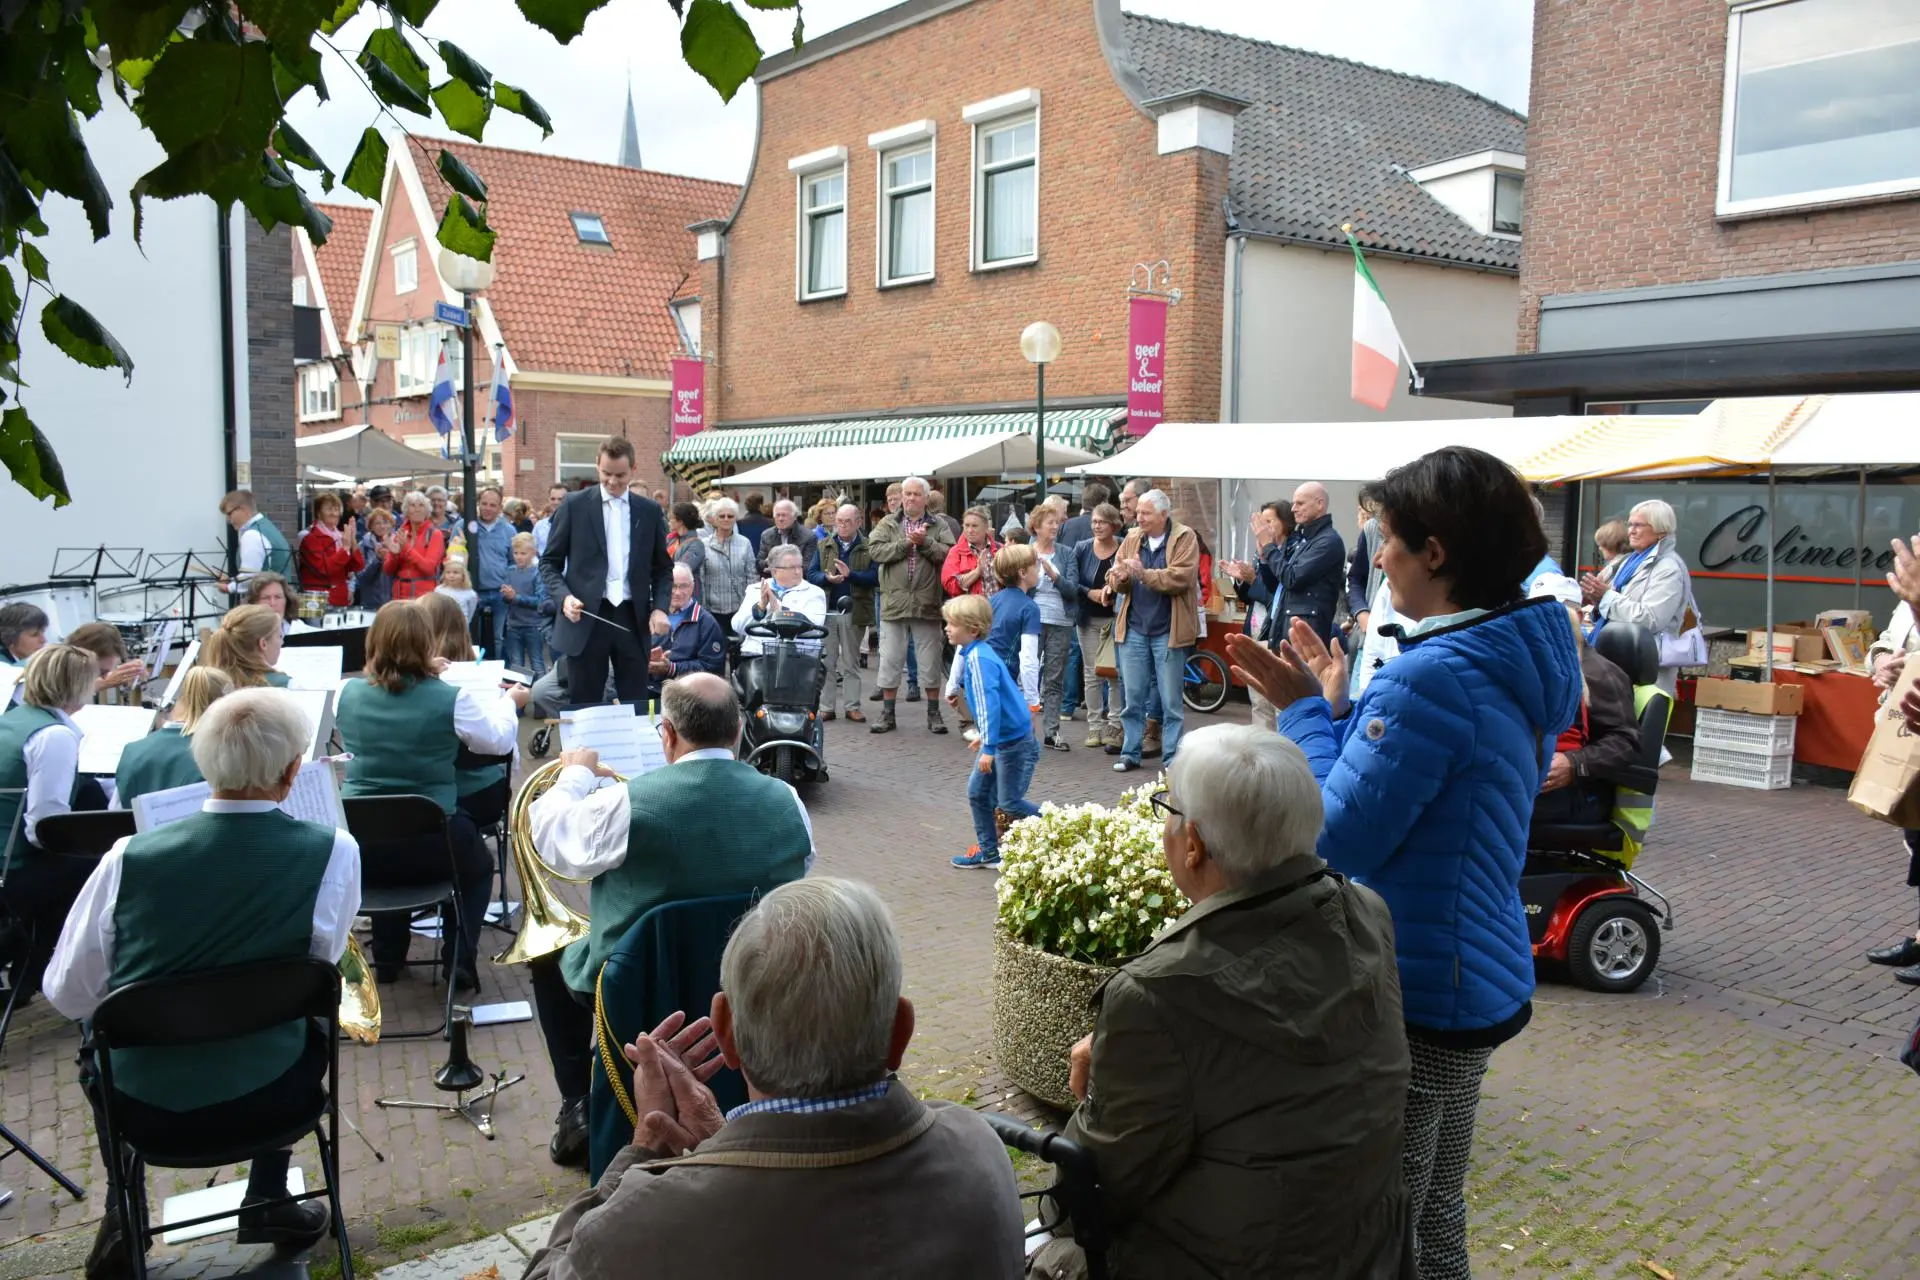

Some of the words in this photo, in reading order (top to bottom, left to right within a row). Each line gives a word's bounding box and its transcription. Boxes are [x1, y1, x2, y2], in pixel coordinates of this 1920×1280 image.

[1135, 342, 1160, 360] geef
[1138, 357, 1157, 378] &
[1131, 377, 1162, 393] beleef
[678, 388, 699, 401] geef
[675, 413, 702, 424] beleef
[1699, 505, 1894, 570] Calimero
[1887, 708, 1906, 721] gee
